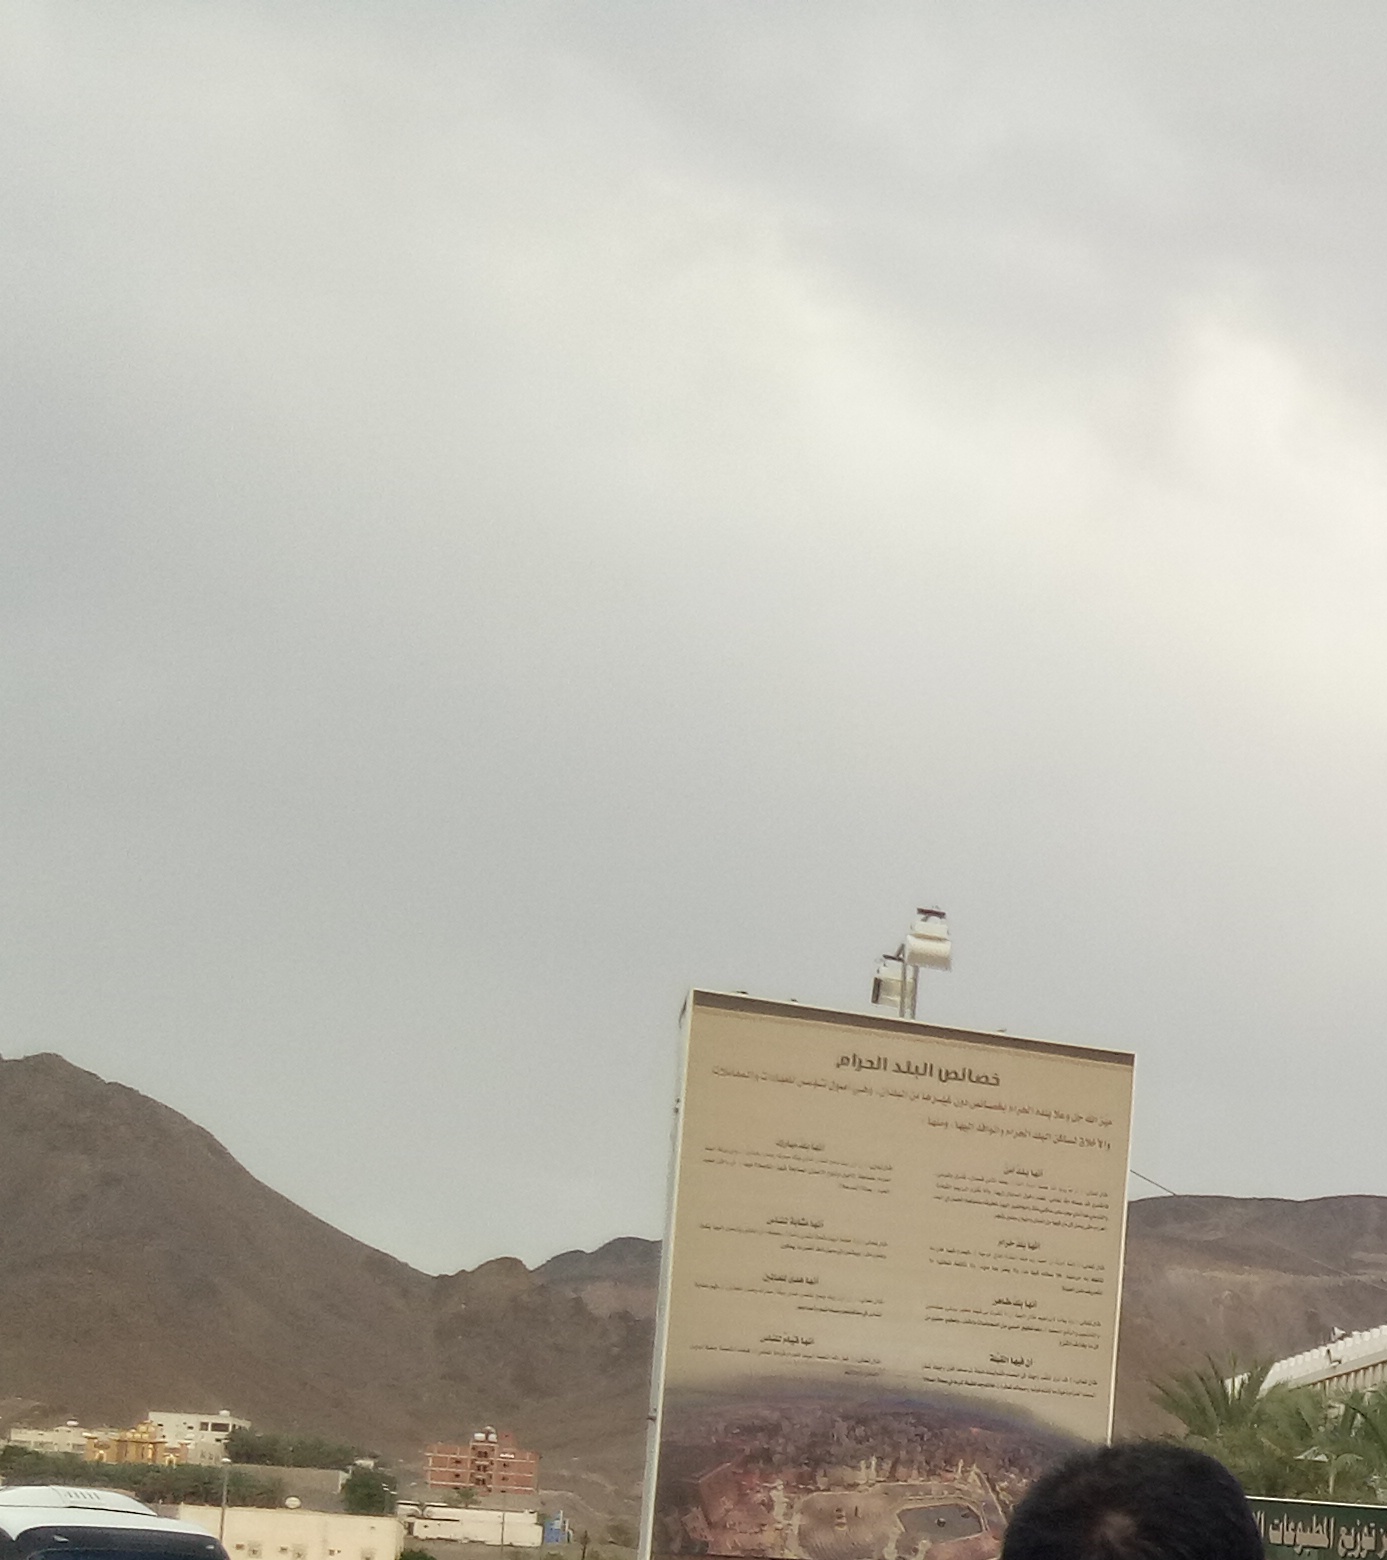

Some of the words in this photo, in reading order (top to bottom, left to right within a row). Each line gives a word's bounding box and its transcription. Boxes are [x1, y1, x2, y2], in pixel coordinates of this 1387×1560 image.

[836, 1053, 888, 1072] الحرام
[891, 1060, 934, 1079] البلد
[938, 1067, 1000, 1086] خصائص
[1268, 1513, 1334, 1556] المطبوعات
[1337, 1519, 1376, 1558] توزيع
